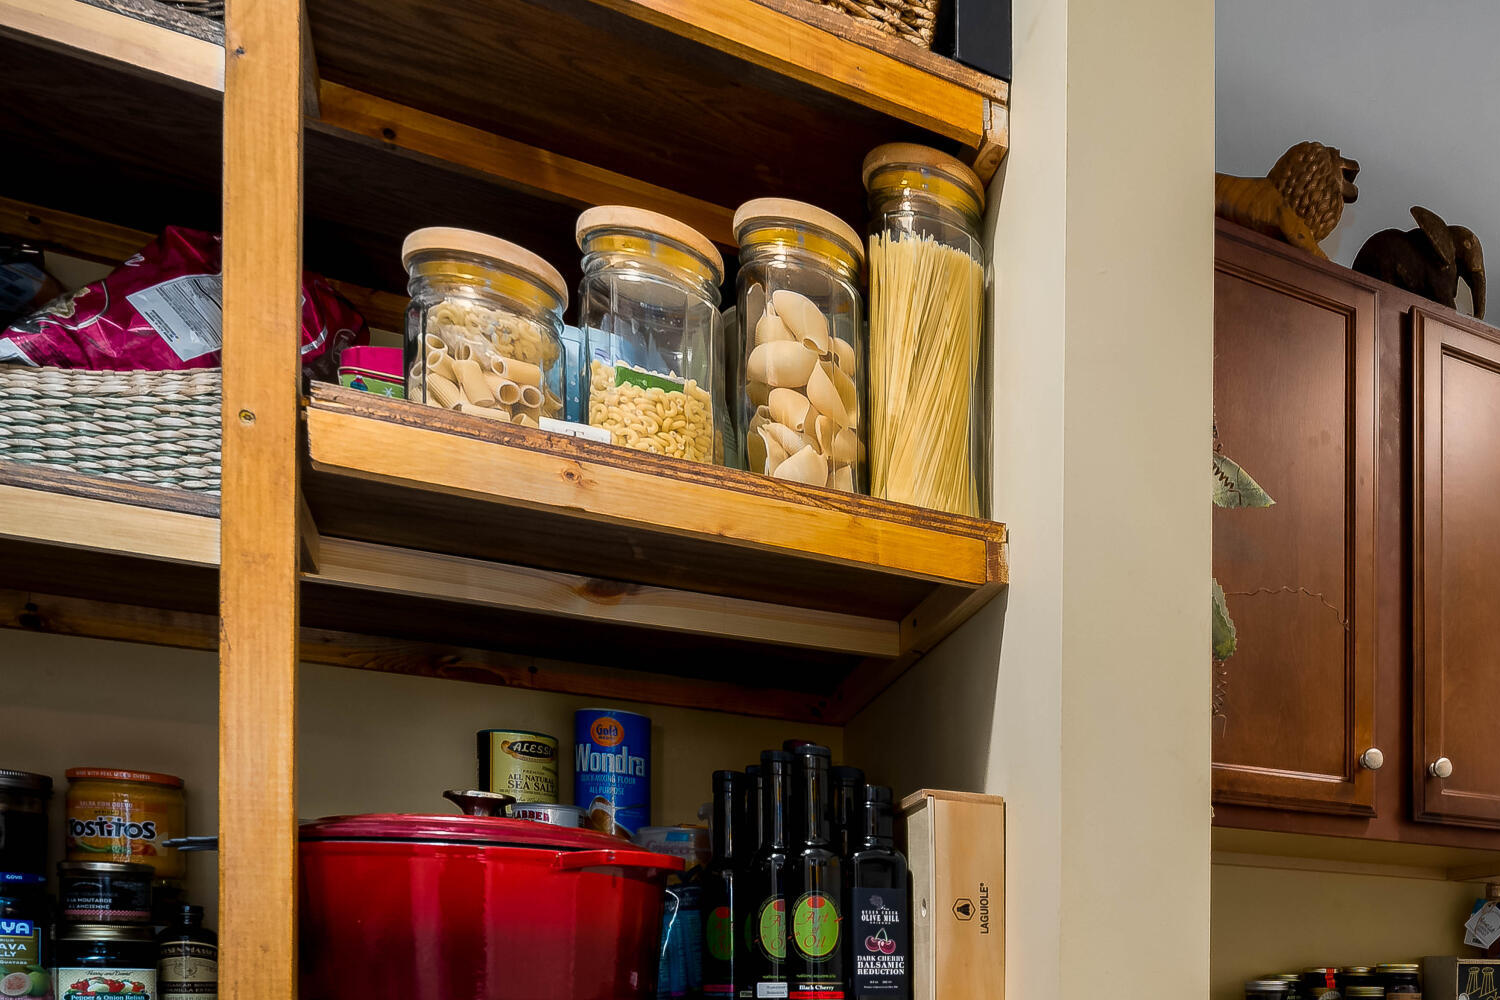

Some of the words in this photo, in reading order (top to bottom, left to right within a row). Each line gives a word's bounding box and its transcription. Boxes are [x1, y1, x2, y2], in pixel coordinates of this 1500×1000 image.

[575, 744, 646, 777] Wondra
[508, 773, 523, 781] ALL
[507, 780, 530, 790] SEA
[69, 816, 156, 840] TOSTITOS
[861, 914, 881, 922] OLIVE
[883, 914, 899, 922] MILL
[857, 961, 905, 969] BALSAMIC
[857, 968, 905, 976] REDUCTION
